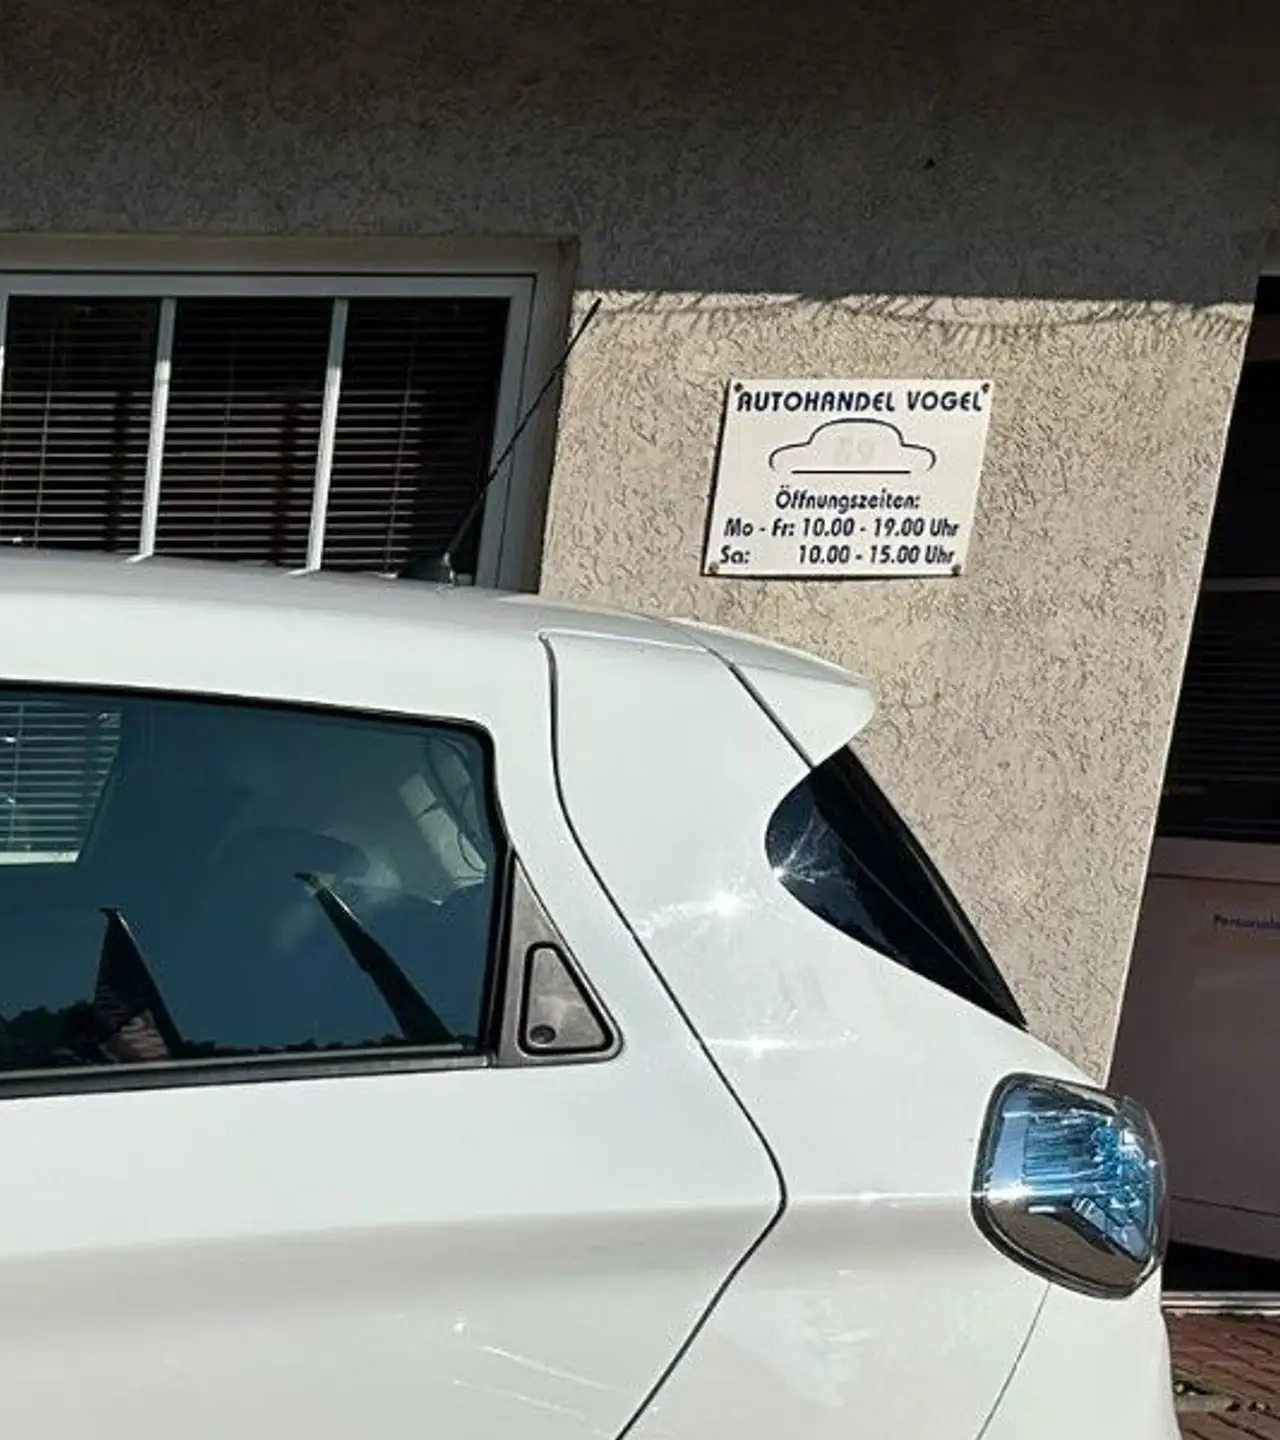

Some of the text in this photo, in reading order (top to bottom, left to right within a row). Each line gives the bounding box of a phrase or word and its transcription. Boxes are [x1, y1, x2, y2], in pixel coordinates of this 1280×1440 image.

[736, 391, 983, 412] AUTOHANDEL VOGEL
[775, 485, 920, 514] Öffnungszeiten:
[723, 518, 754, 538] Mo
[771, 518, 796, 538] Fr:
[803, 518, 855, 538] 10.00
[874, 518, 925, 538] 19.00
[929, 517, 960, 537] Uhr
[719, 545, 751, 565] Sa:
[798, 545, 850, 565] 10.00
[870, 545, 920, 565] 15.00
[924, 545, 955, 565] Uhr
